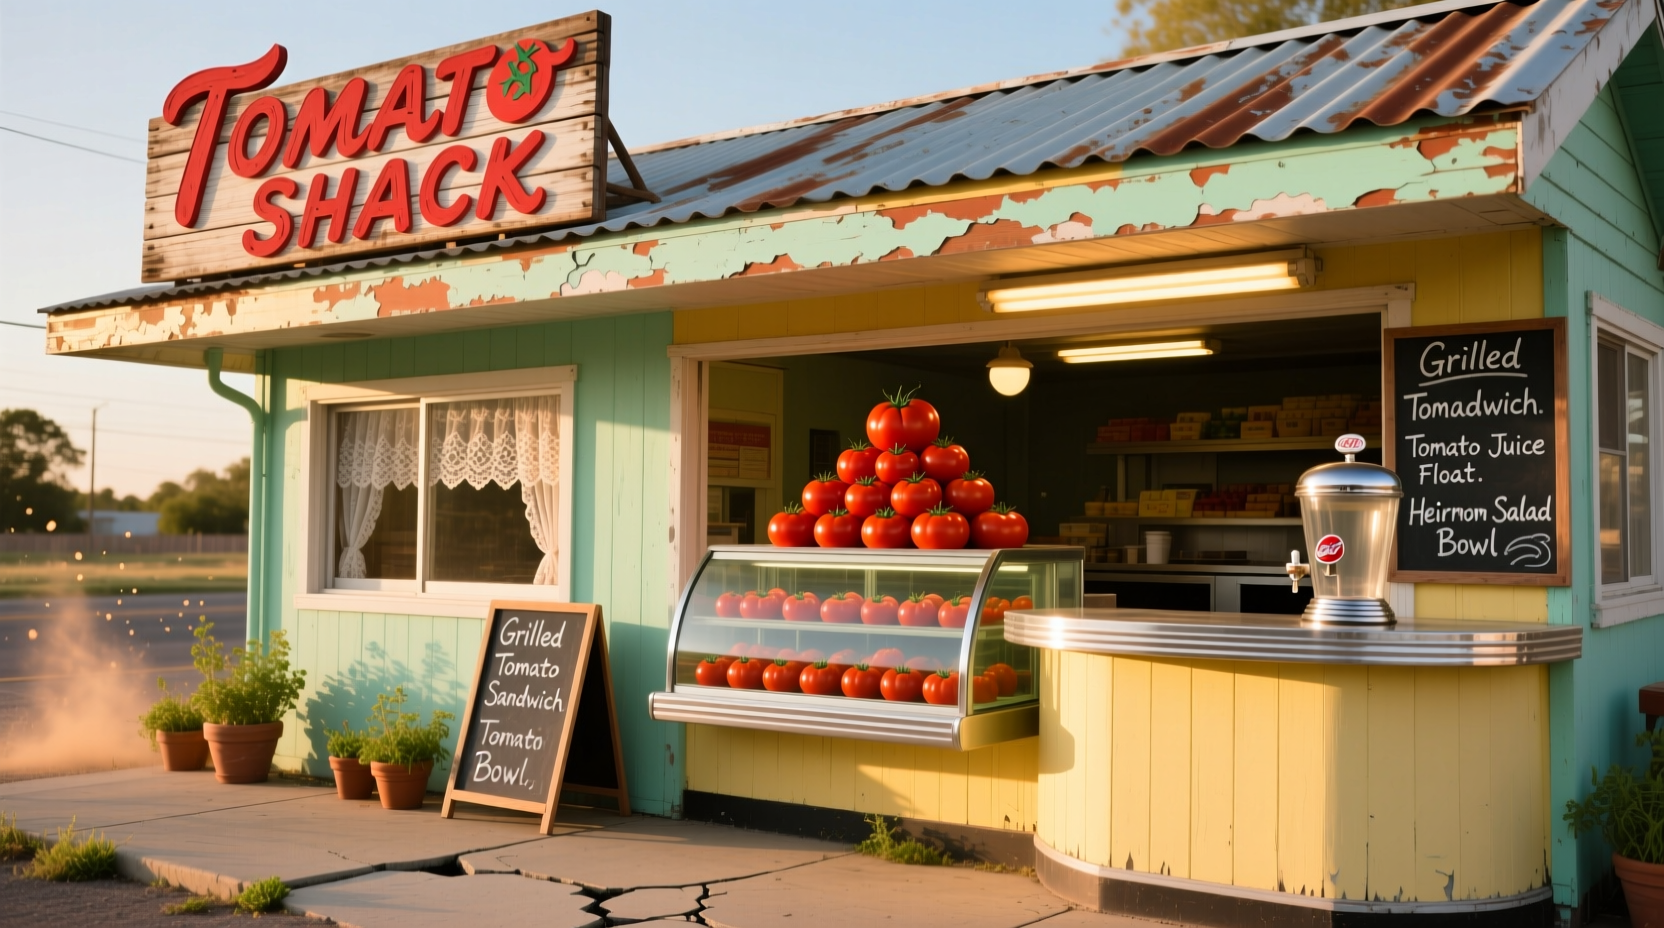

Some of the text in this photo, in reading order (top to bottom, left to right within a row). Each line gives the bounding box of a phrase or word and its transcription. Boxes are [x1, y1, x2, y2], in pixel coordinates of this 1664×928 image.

[163, 37, 578, 228] TOMATO
[242, 129, 546, 258] SHACK
[1419, 337, 1522, 376] Grilled
[1404, 388, 1543, 421] Tomadwich.
[1405, 433, 1545, 458] Tomato Juice
[1419, 462, 1483, 485] Float.
[1492, 495, 1552, 523] Salad
[1436, 527, 1498, 557] Bowl
[500, 616, 566, 648] Grilled
[495, 652, 559, 678] Tomato
[484, 680, 563, 712] Sandwich
[480, 719, 543, 750] Tomato
